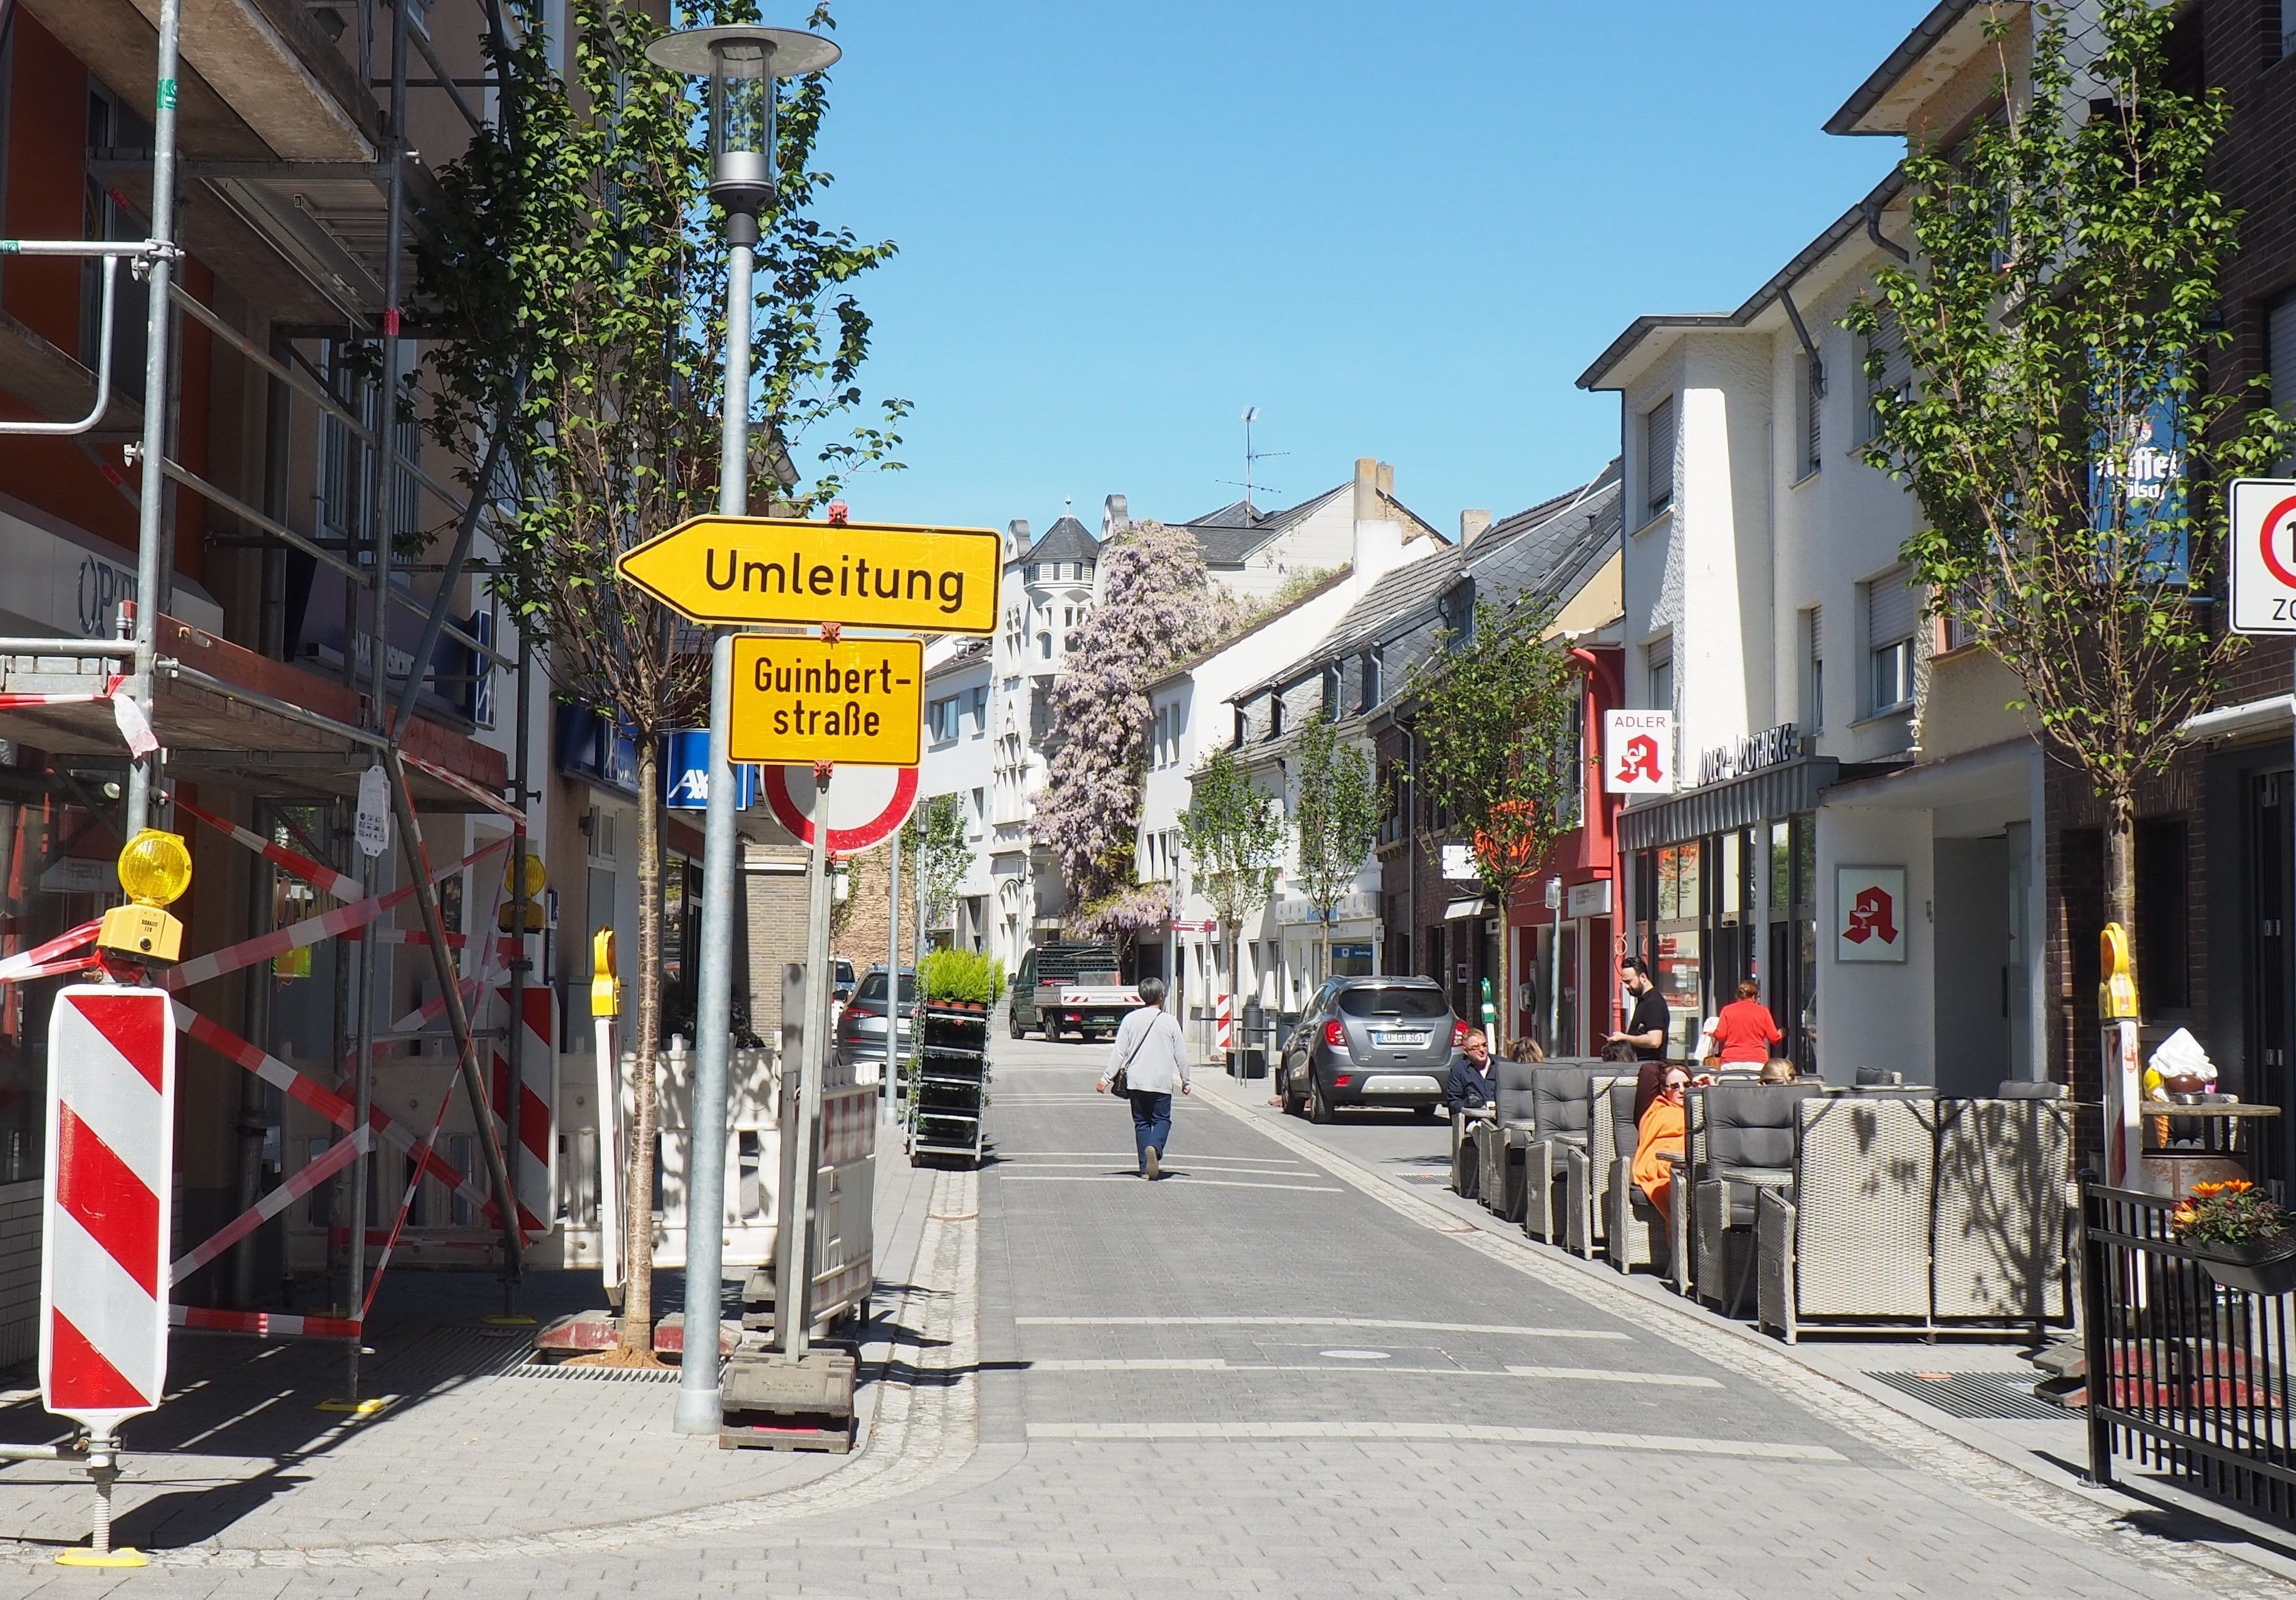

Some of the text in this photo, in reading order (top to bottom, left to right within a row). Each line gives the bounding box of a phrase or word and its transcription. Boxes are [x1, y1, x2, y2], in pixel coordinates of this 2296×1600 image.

[706, 548, 964, 614] Umleitung
[754, 657, 911, 695] Guinbert-
[773, 699, 880, 737] straße
[1614, 716, 1666, 728] ADLER
